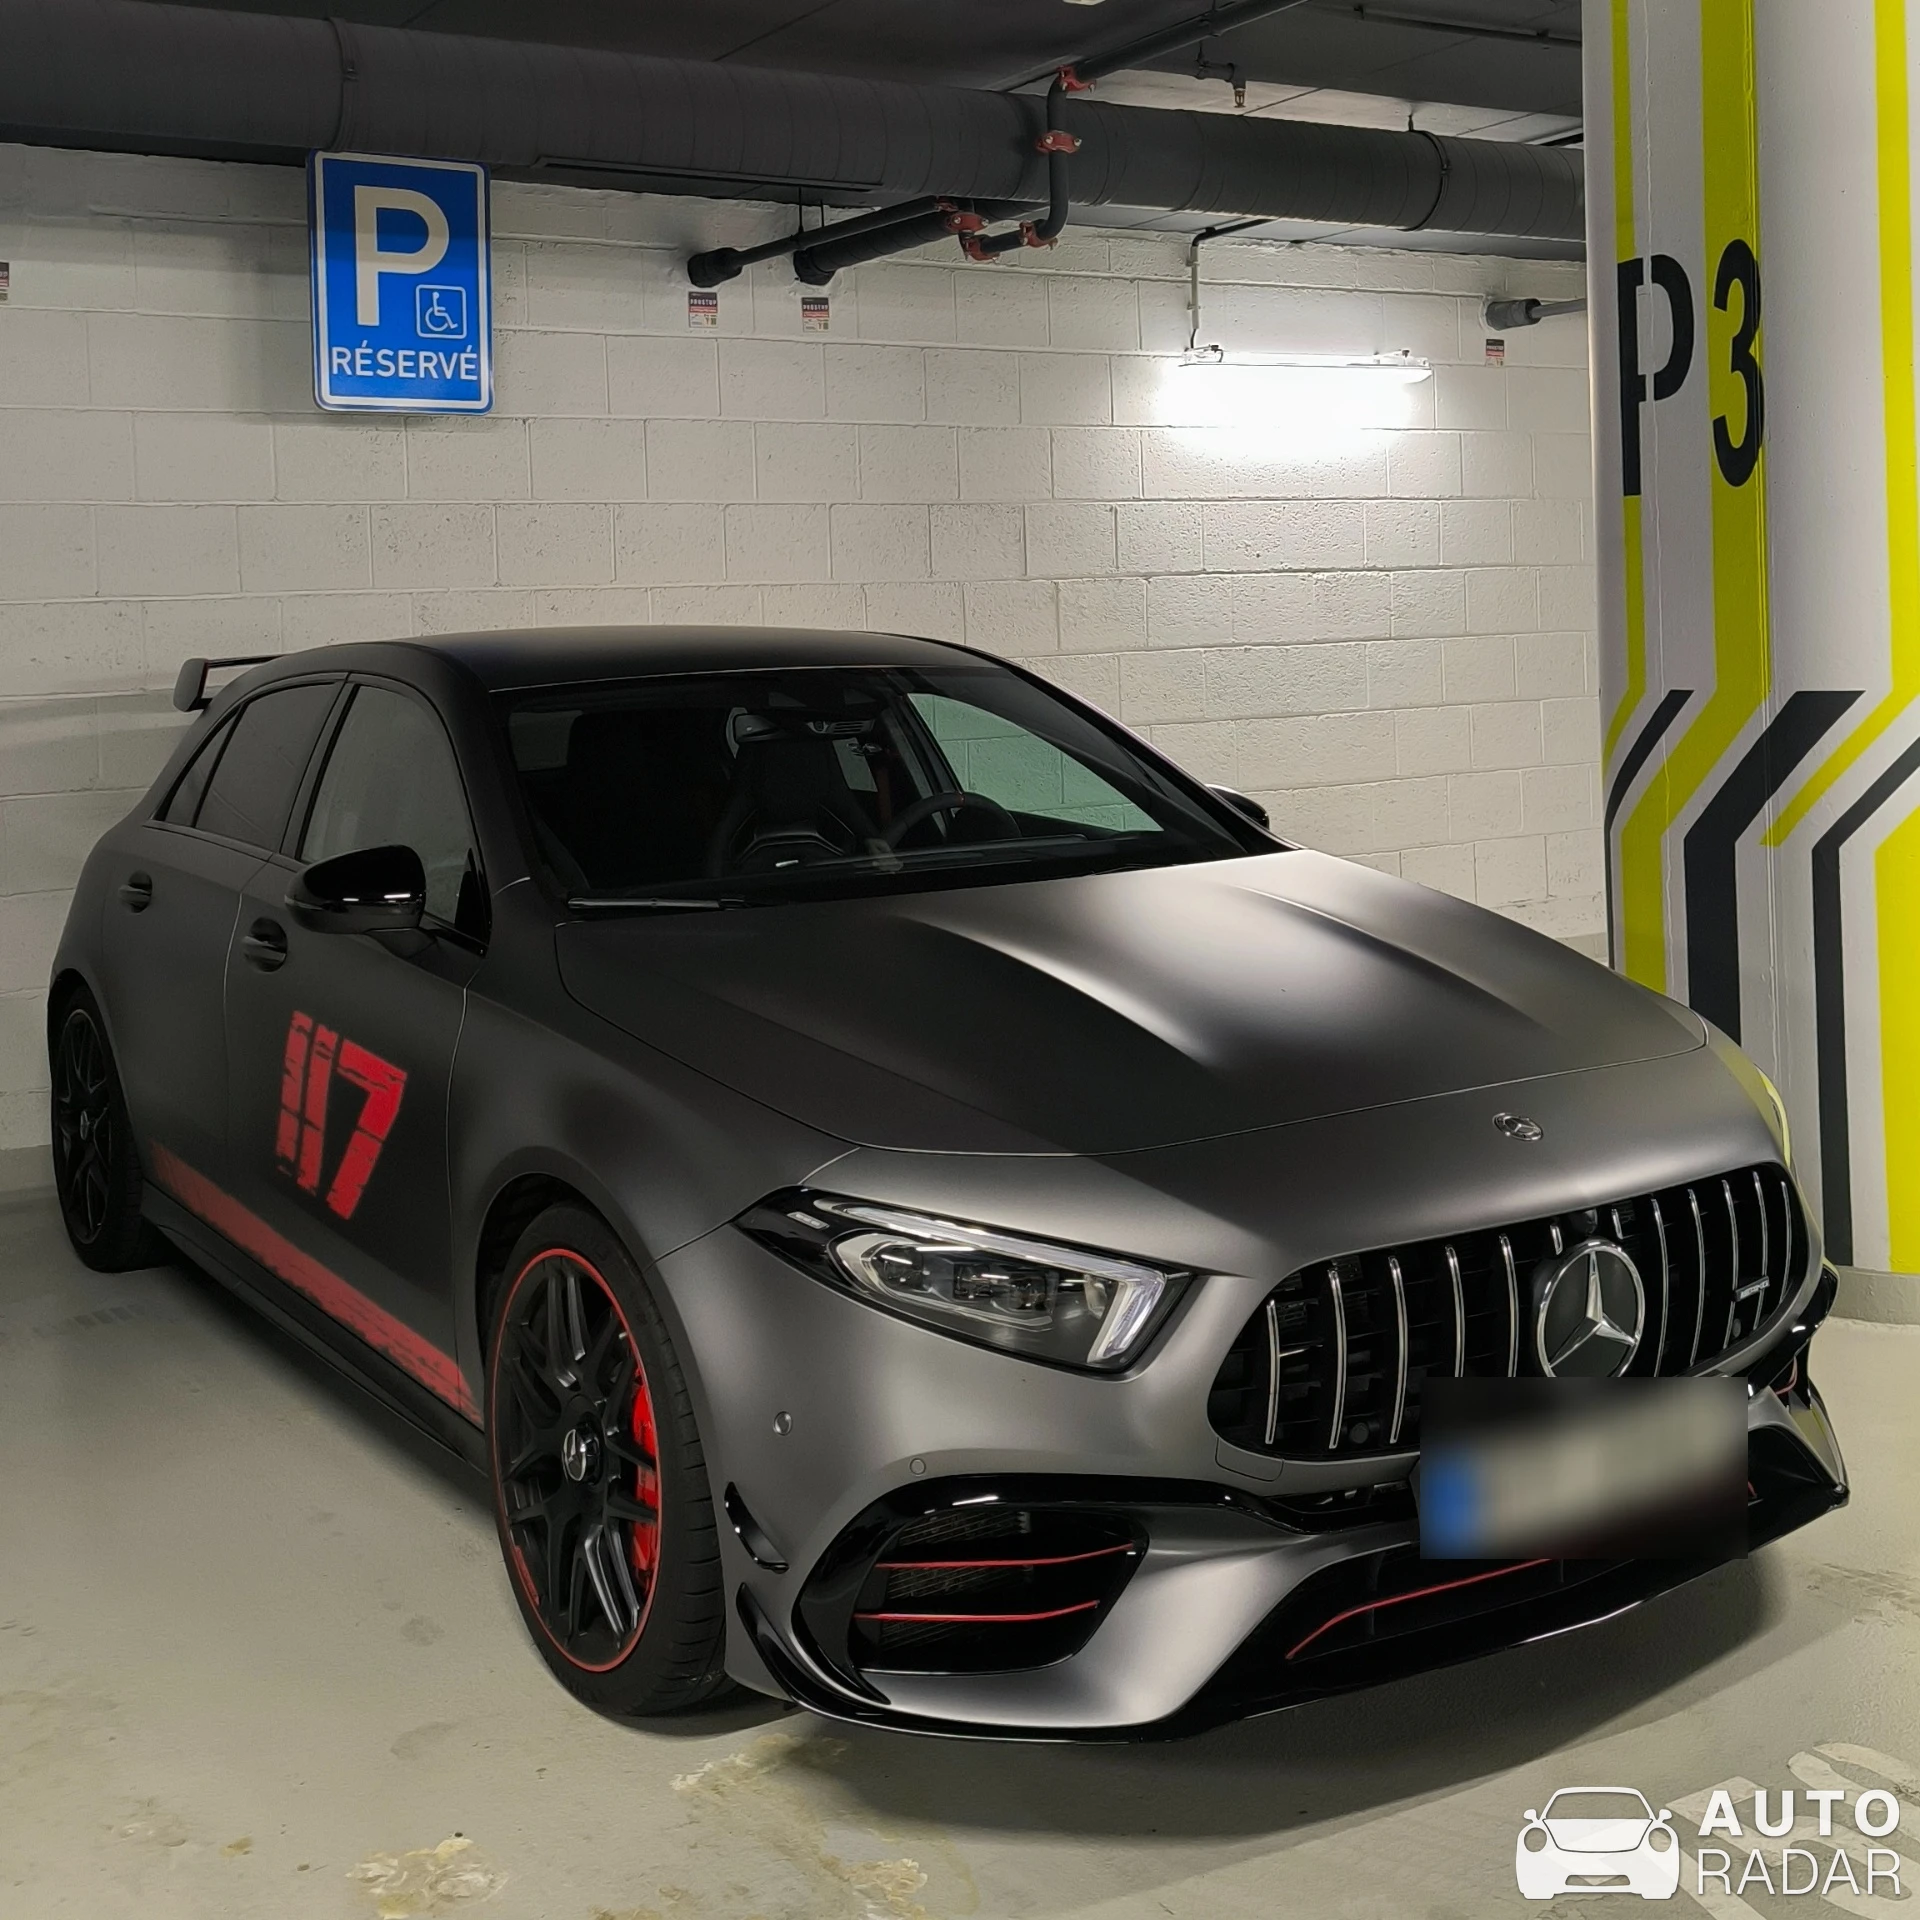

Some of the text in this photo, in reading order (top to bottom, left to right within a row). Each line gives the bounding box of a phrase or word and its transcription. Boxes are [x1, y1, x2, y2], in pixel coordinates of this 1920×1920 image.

[354, 185, 449, 326] P
[331, 340, 478, 381] RÉSERVÉ
[1617, 239, 1764, 496] P 3
